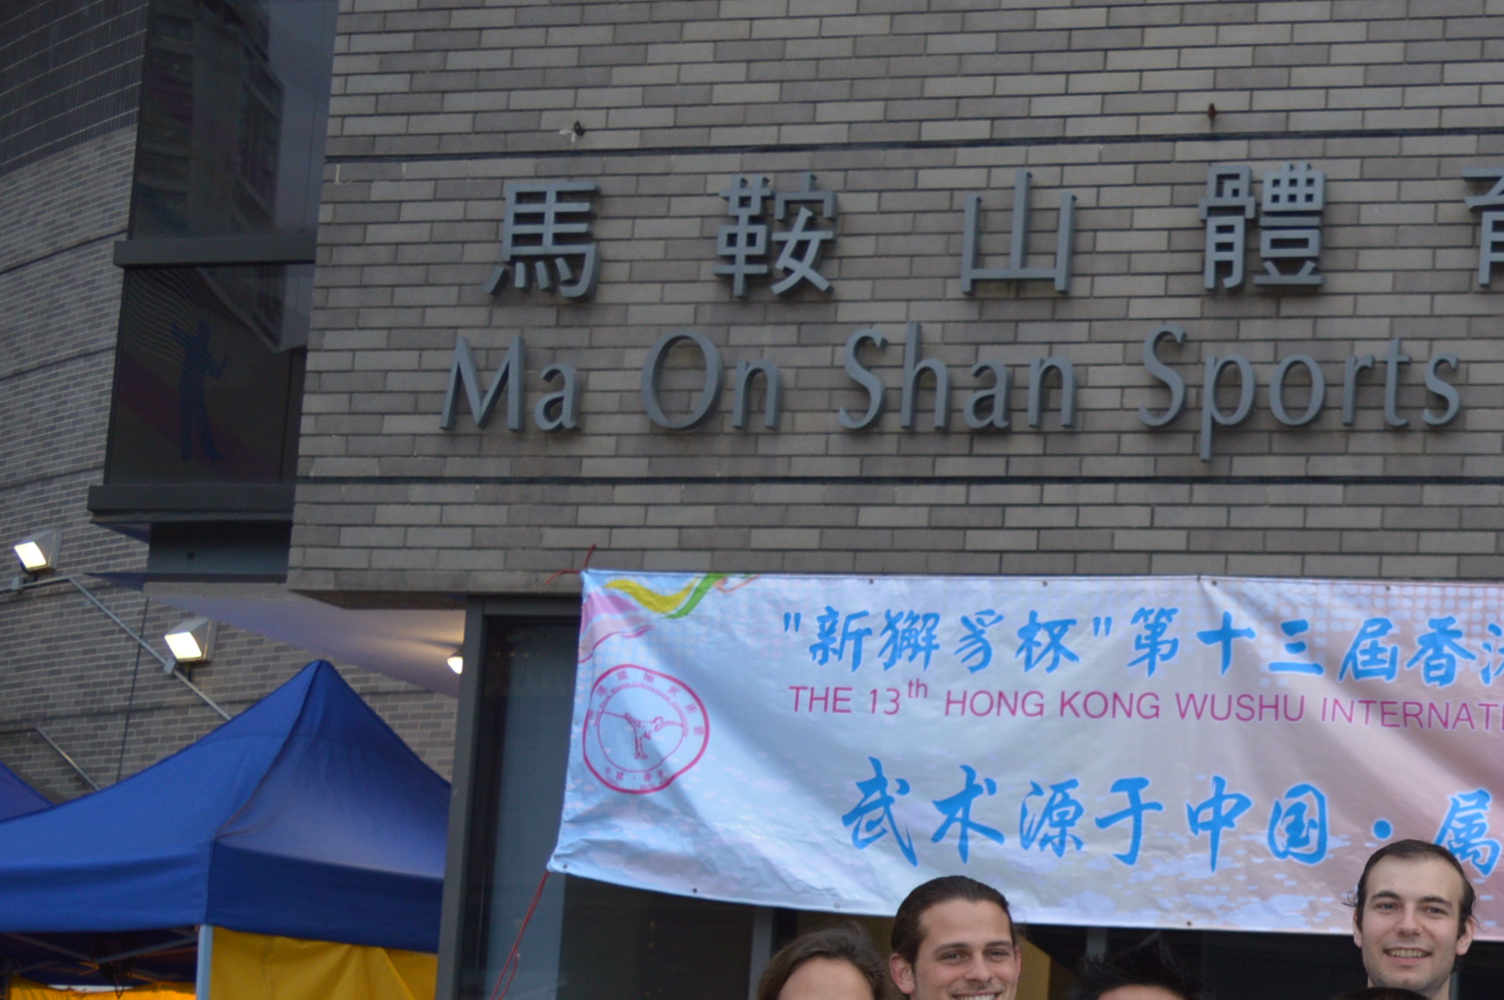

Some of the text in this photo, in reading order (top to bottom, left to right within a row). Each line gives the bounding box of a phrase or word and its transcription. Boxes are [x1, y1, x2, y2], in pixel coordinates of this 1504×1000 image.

[440, 334, 582, 432] Ma
[641, 331, 781, 431] On
[838, 322, 1078, 431] Shan
[1137, 321, 1464, 461] Sports
[787, 684, 854, 715] THE
[868, 677, 929, 716] 13th
[944, 688, 1046, 718] HONG
[1058, 689, 1162, 720] KONG
[1174, 692, 1305, 722] WUSHU
